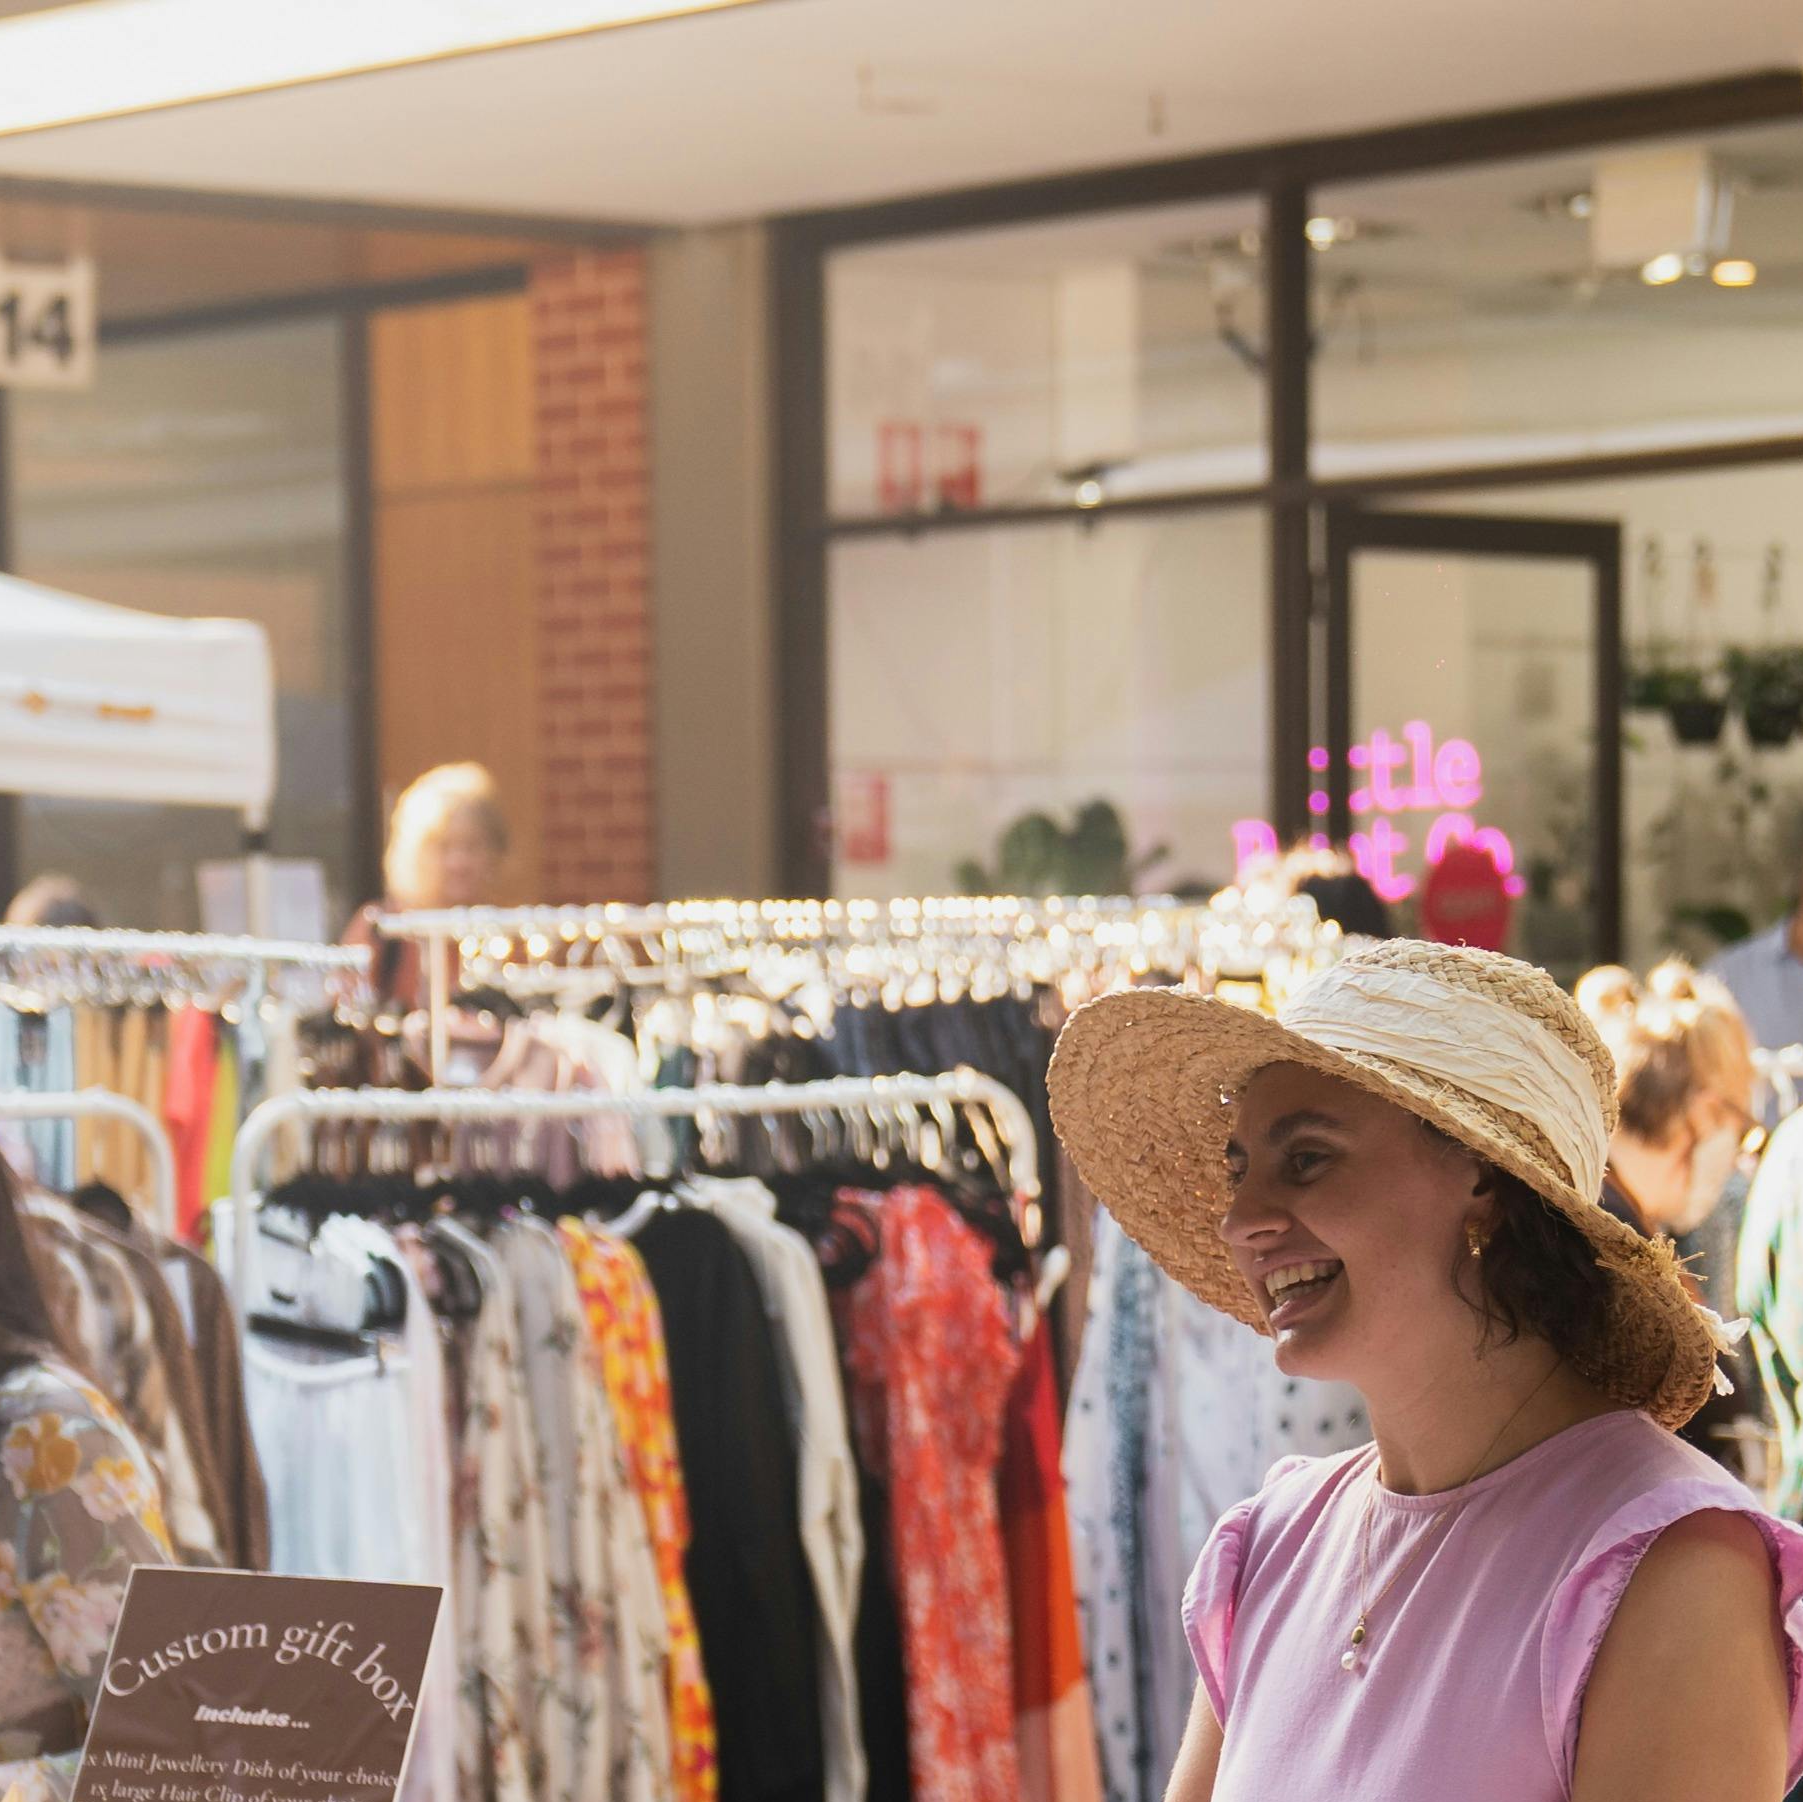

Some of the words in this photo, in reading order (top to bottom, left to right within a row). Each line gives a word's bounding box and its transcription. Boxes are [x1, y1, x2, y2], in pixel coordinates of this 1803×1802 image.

[103, 1621, 269, 1698] Custom
[274, 1619, 355, 1666] gift
[351, 1641, 416, 1722] box
[102, 1750, 146, 1770] Mini
[145, 1752, 229, 1780] Jewellery
[232, 1758, 275, 1779] Dish
[278, 1760, 303, 1780] of
[297, 1769, 342, 1787] your
[159, 1782, 202, 1802] Hair
